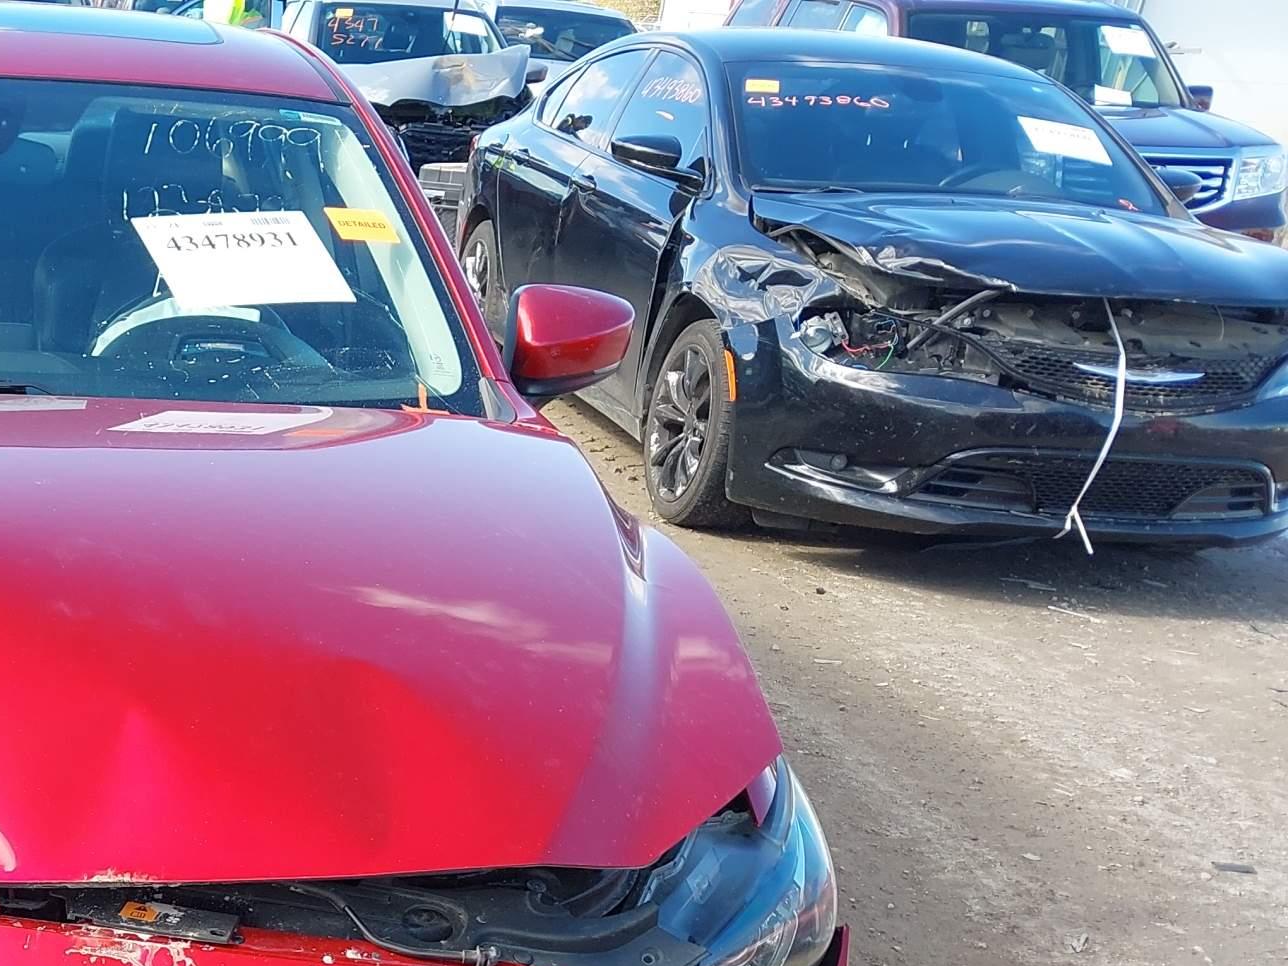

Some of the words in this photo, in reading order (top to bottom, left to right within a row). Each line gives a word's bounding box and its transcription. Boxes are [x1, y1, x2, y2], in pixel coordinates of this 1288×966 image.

[144, 116, 325, 176] 106999
[337, 220, 387, 229] DETAILED
[167, 231, 298, 252] 43478931
